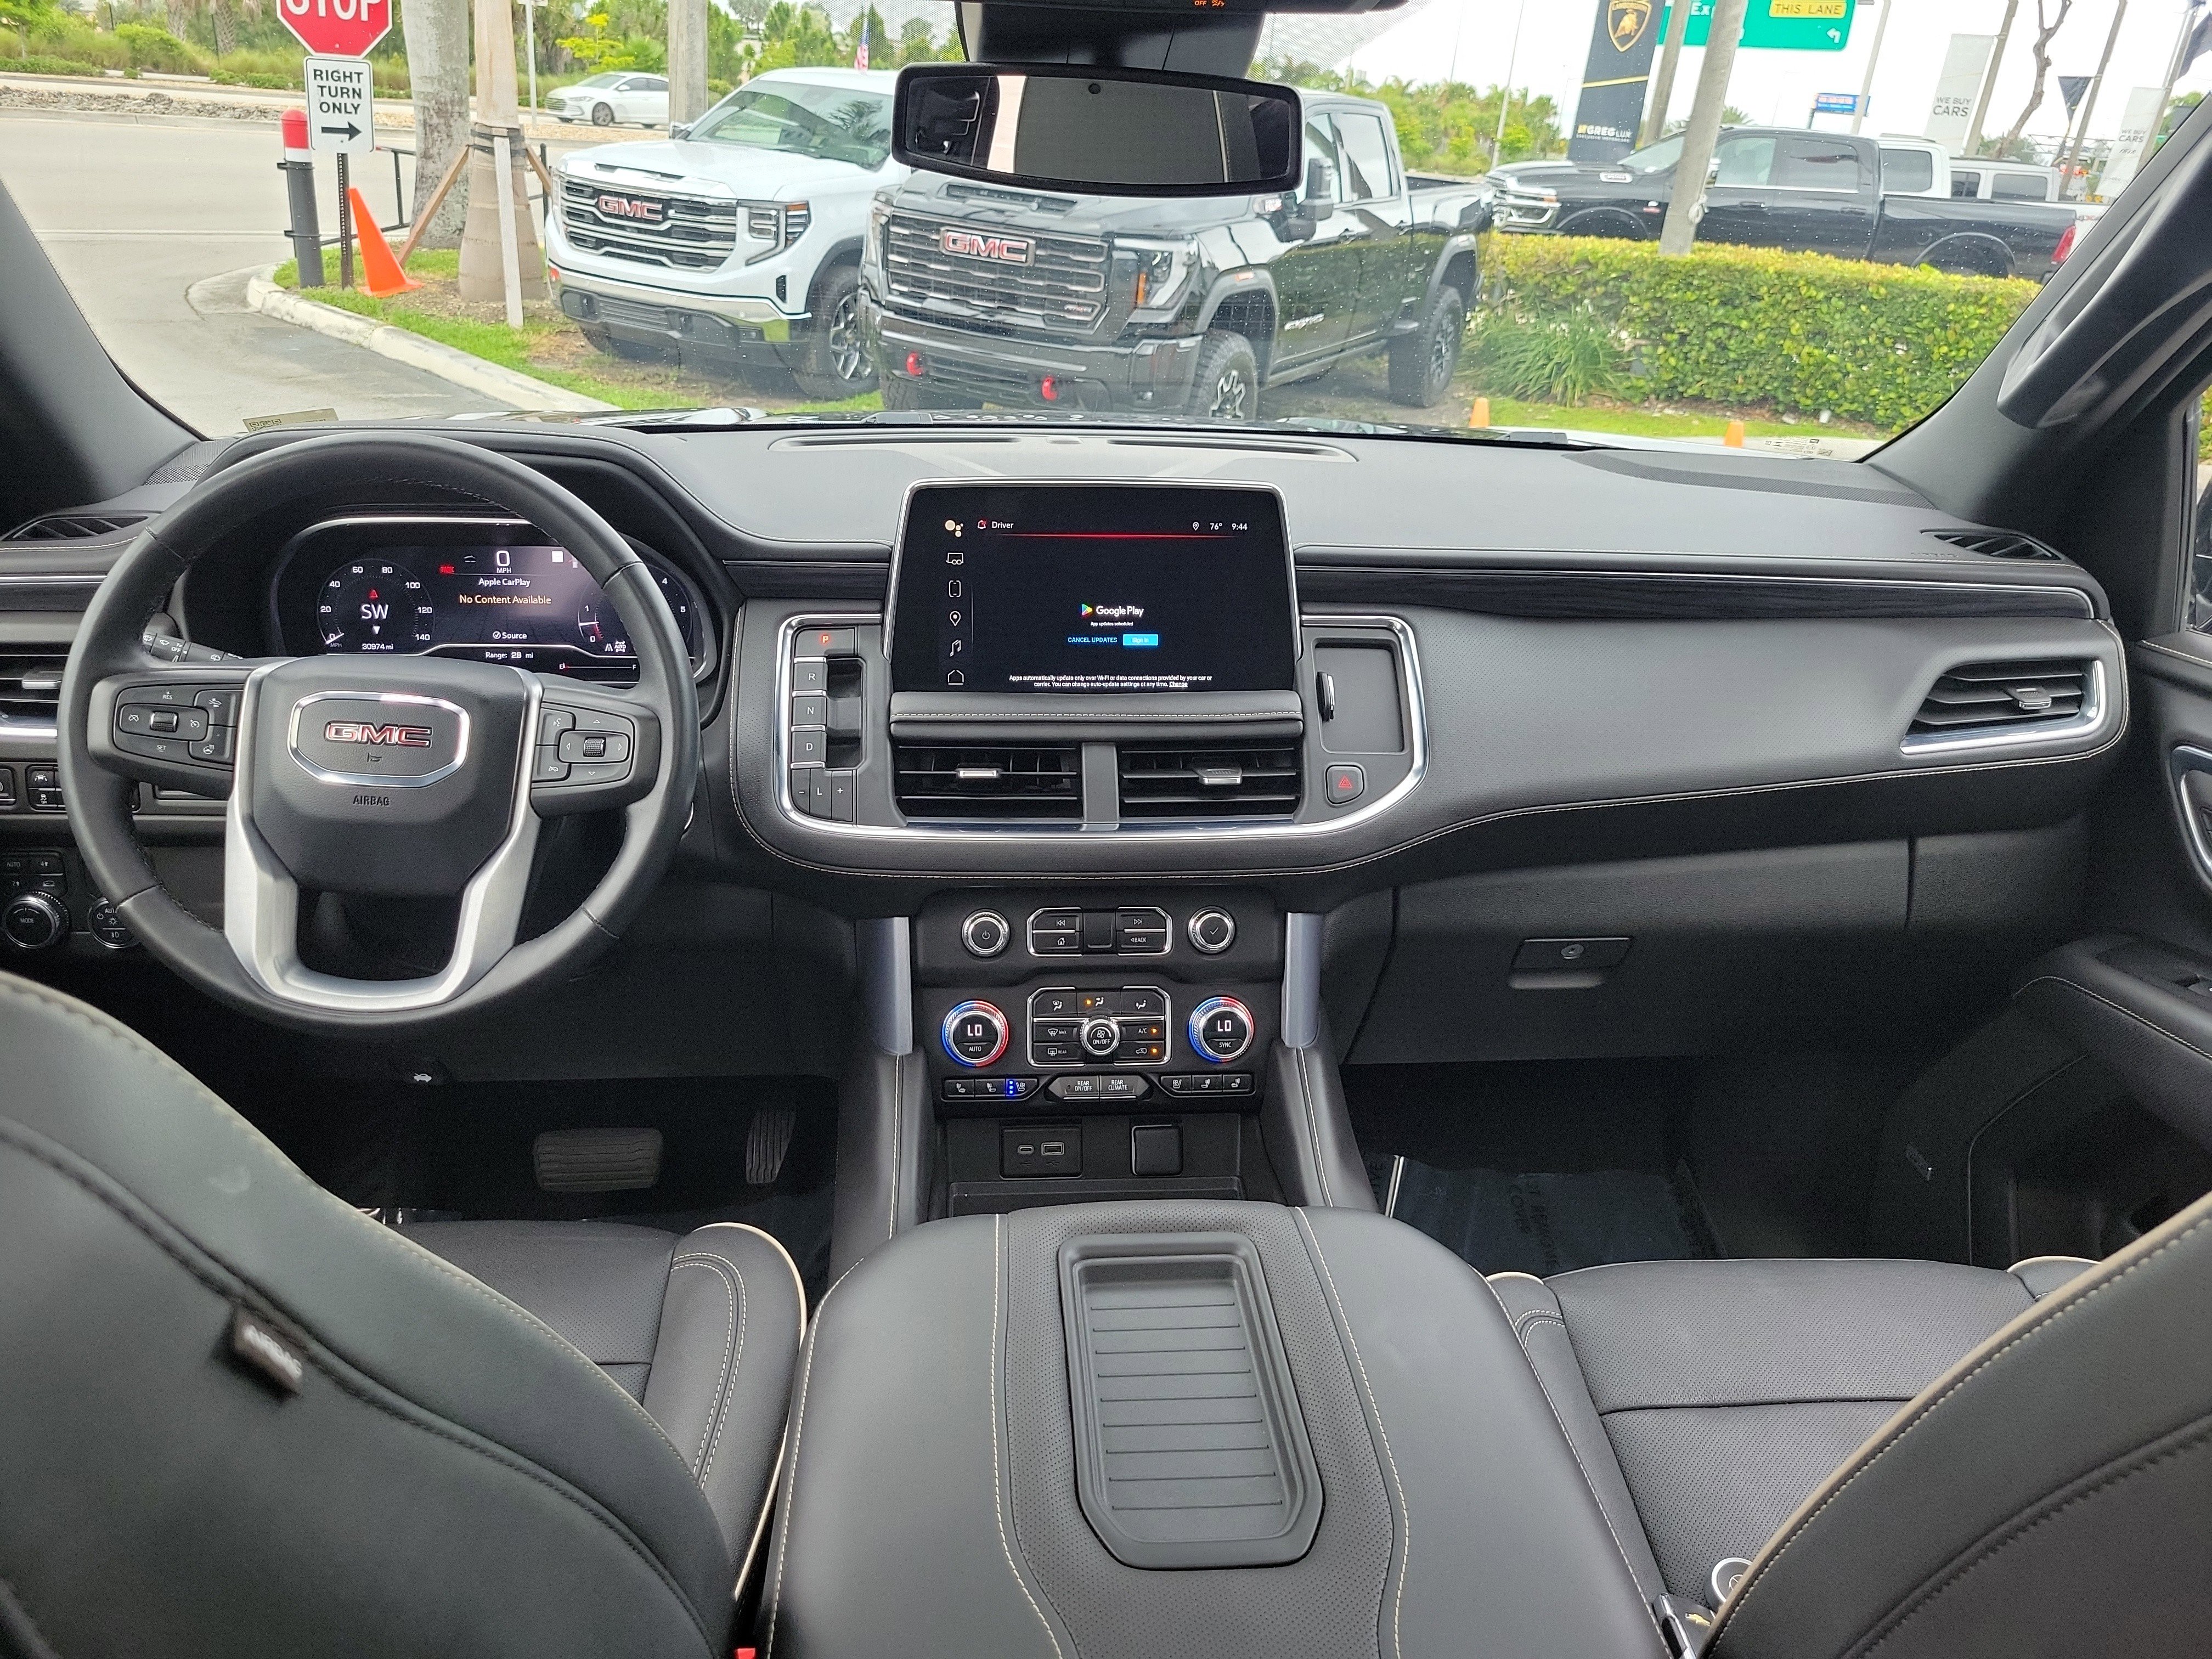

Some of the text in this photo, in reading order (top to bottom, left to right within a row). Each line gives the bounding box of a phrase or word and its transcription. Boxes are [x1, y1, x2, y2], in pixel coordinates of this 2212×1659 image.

[1775, 4, 1842, 15] THIS LANE
[313, 69, 363, 83] RIGHT
[317, 85, 362, 99] TURN
[319, 101, 361, 115] ONLY
[1933, 105, 1969, 117] CARS
[599, 195, 663, 221] GMC
[944, 231, 1028, 263] GMC
[1210, 522, 1223, 531] 76°
[496, 550, 510, 567] 0
[478, 578, 531, 587] Apple CarPlay
[459, 595, 552, 604] No Content Available
[361, 603, 389, 619] SW
[1096, 605, 1144, 617] Google Play
[486, 652, 507, 660] Range:
[328, 722, 432, 748] GMC
[806, 743, 814, 751] D
[817, 787, 822, 795] L
[353, 795, 390, 806] AIRBAG
[967, 1024, 982, 1036] LO
[1217, 1020, 1232, 1032] LO
